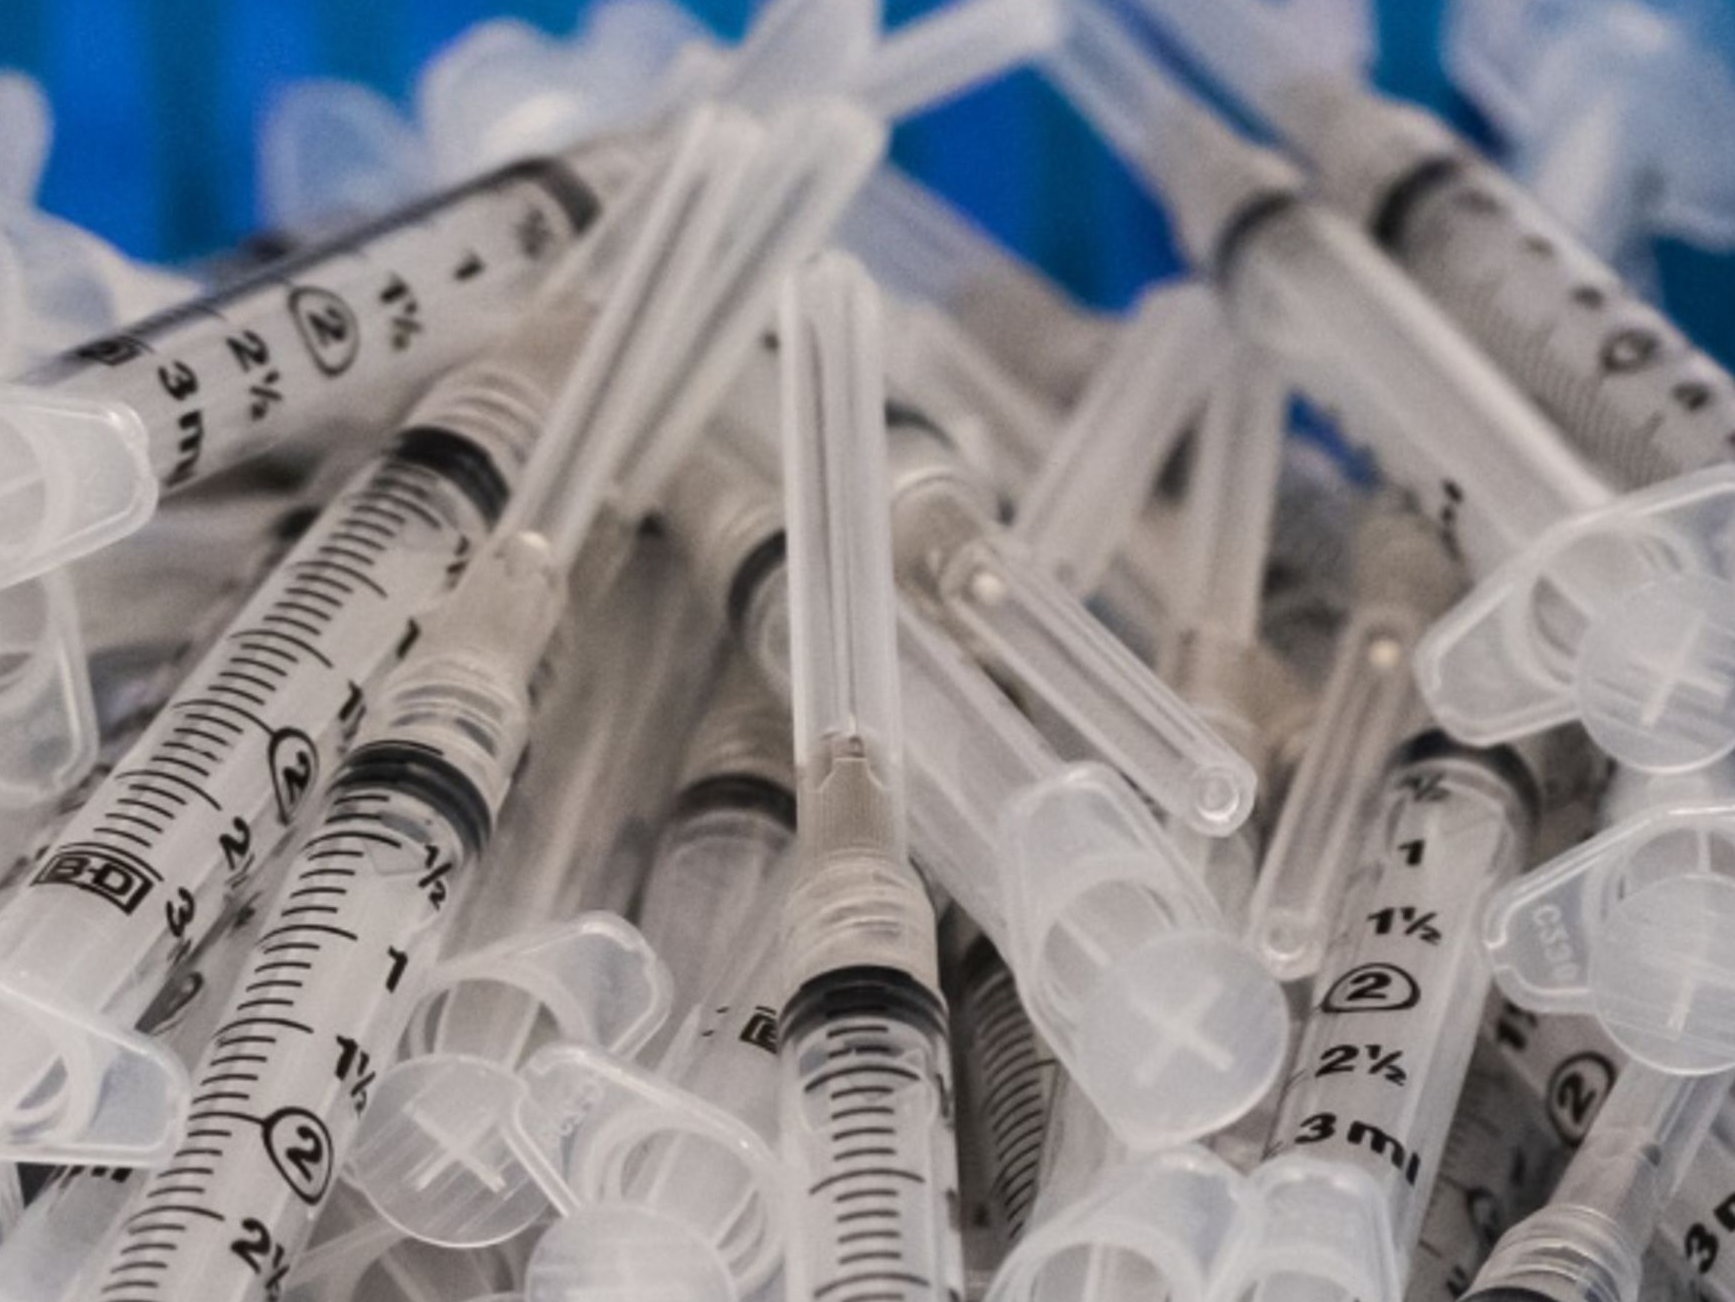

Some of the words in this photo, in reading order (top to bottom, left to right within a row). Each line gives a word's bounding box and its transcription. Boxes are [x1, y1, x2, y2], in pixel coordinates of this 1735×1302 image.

[166, 886, 195, 938] 3
[1345, 971, 1392, 1002] 2
[1315, 1043, 1407, 1086] 2½
[284, 1126, 324, 1182] 2
[1296, 1113, 1337, 1144] 3
[1345, 1120, 1421, 1186] ml
[1685, 1221, 1720, 1274] 3
